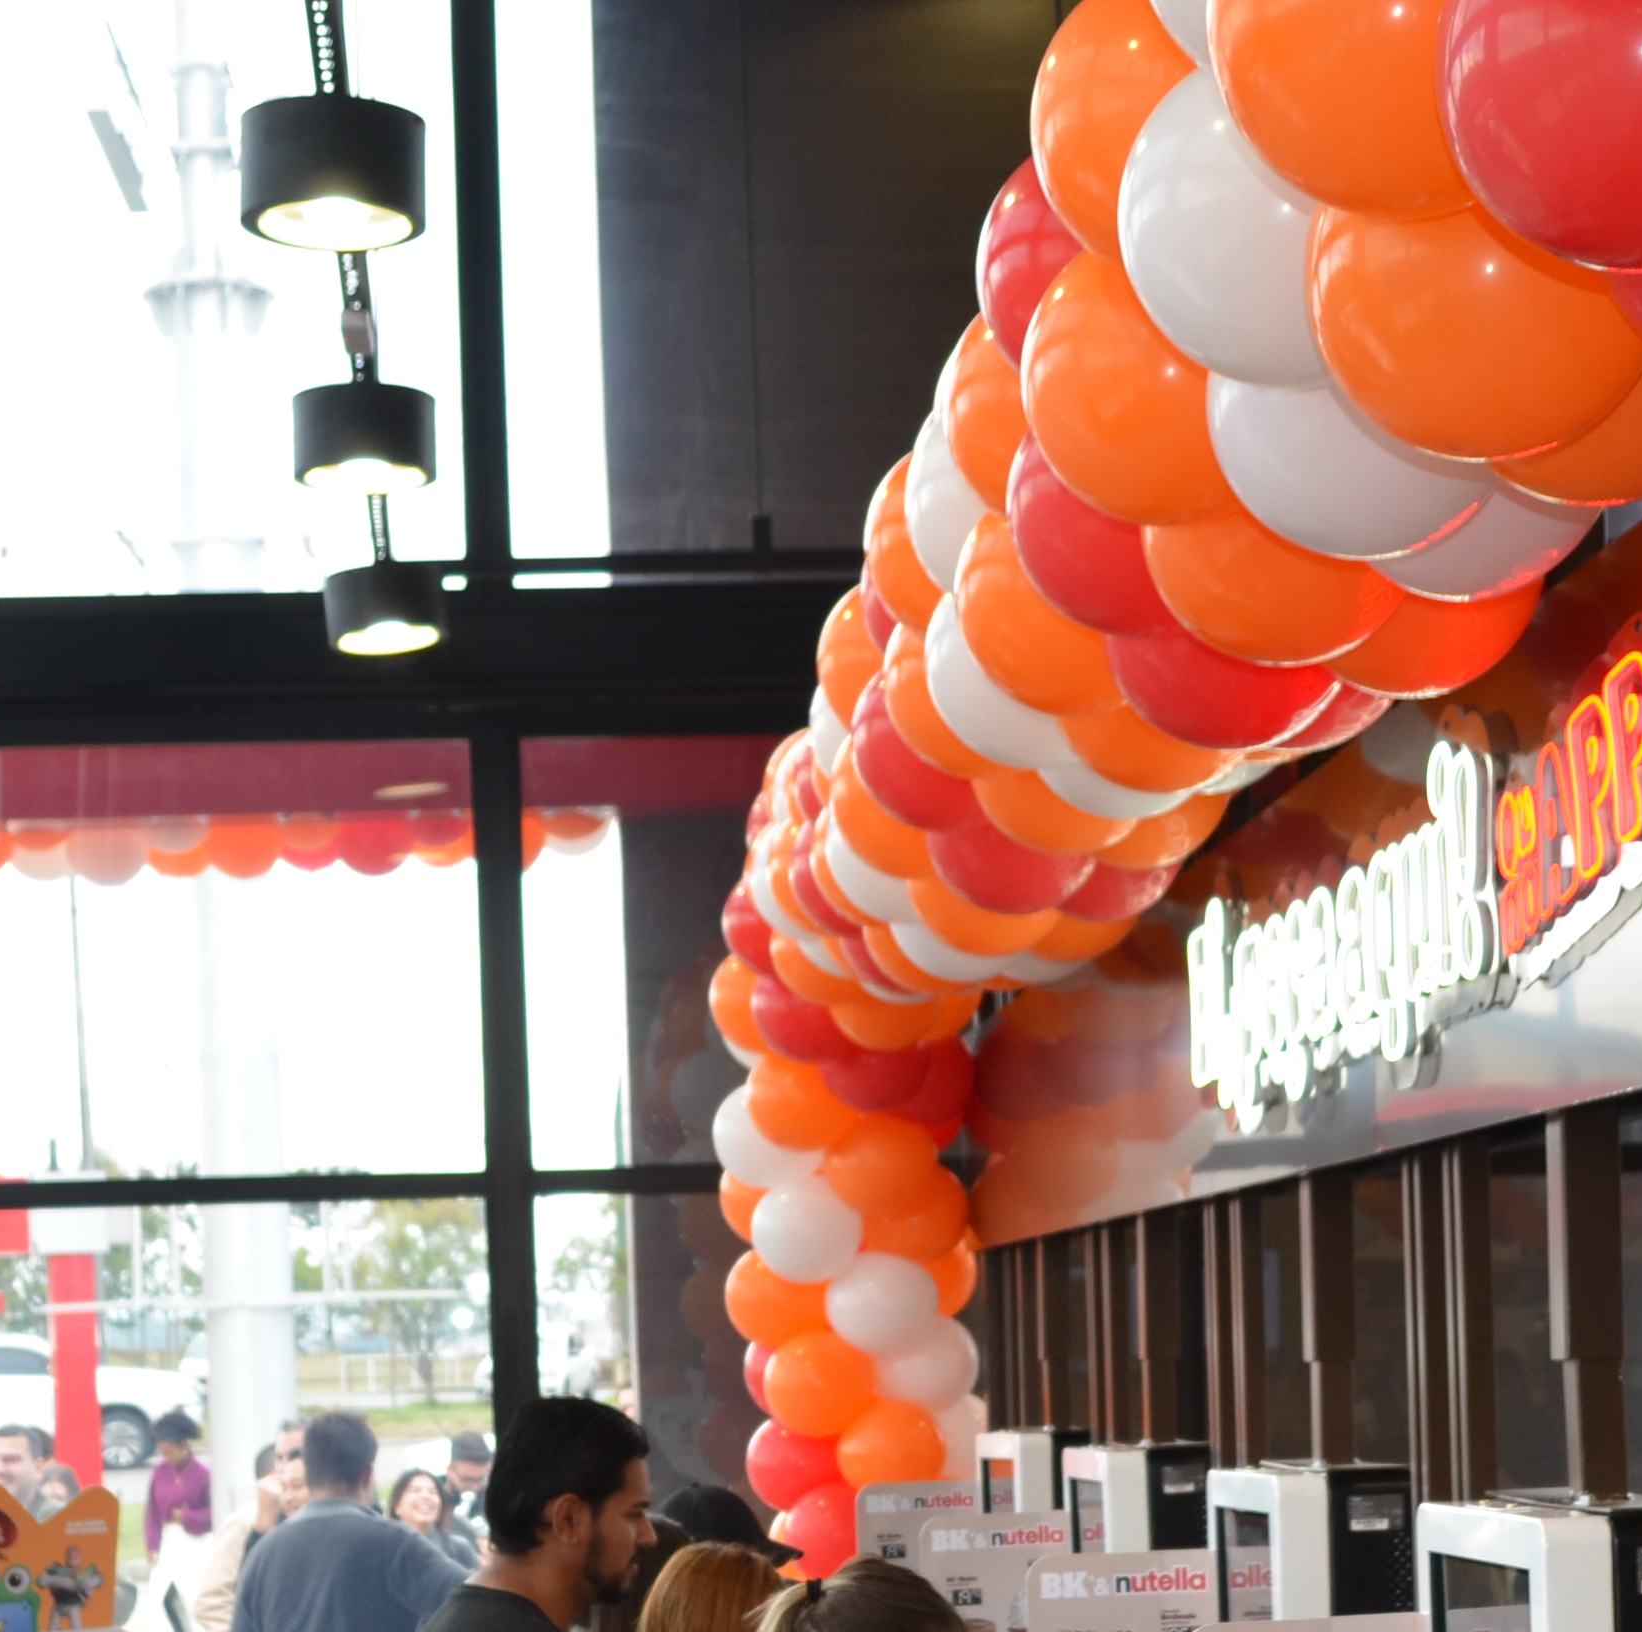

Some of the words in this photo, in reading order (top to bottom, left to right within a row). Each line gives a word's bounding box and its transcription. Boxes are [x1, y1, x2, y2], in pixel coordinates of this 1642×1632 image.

[865, 1494, 897, 1513] BK
[914, 1491, 974, 1509] nutella
[931, 1529, 970, 1551] BK
[991, 1525, 1065, 1546] nutella
[1040, 1571, 1089, 1599] BK
[1115, 1567, 1206, 1594] nutella
